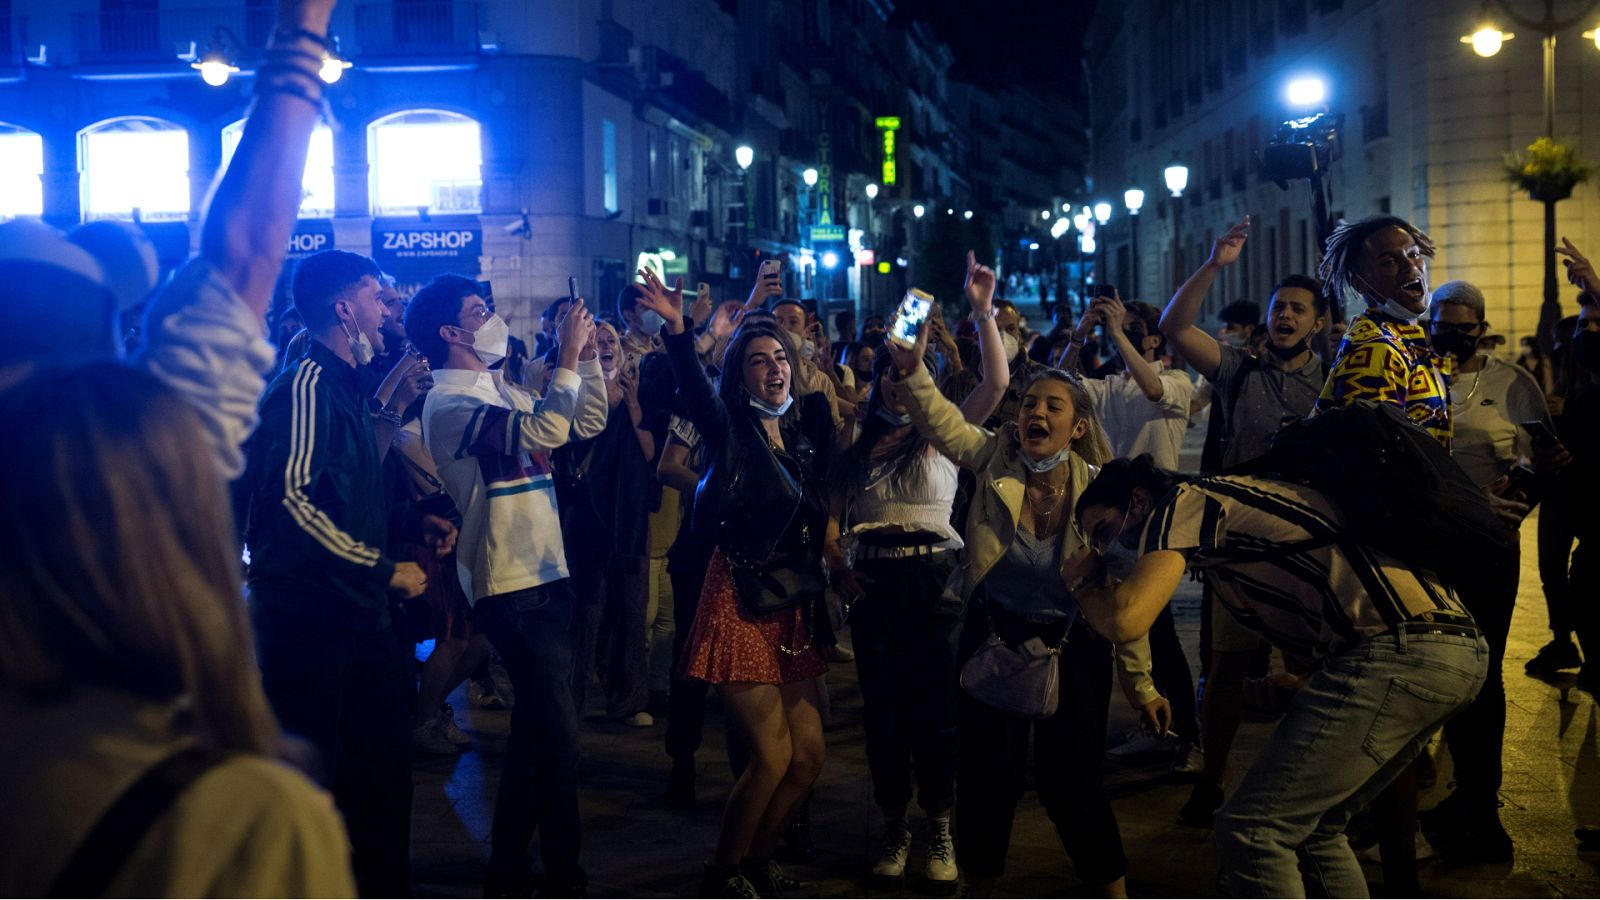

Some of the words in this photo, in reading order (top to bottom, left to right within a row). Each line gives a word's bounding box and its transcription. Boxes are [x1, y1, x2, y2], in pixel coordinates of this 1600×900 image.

[818, 101, 831, 225] VICTORIA
[288, 234, 326, 251] HOP
[383, 231, 473, 249] ZAPSHOP
